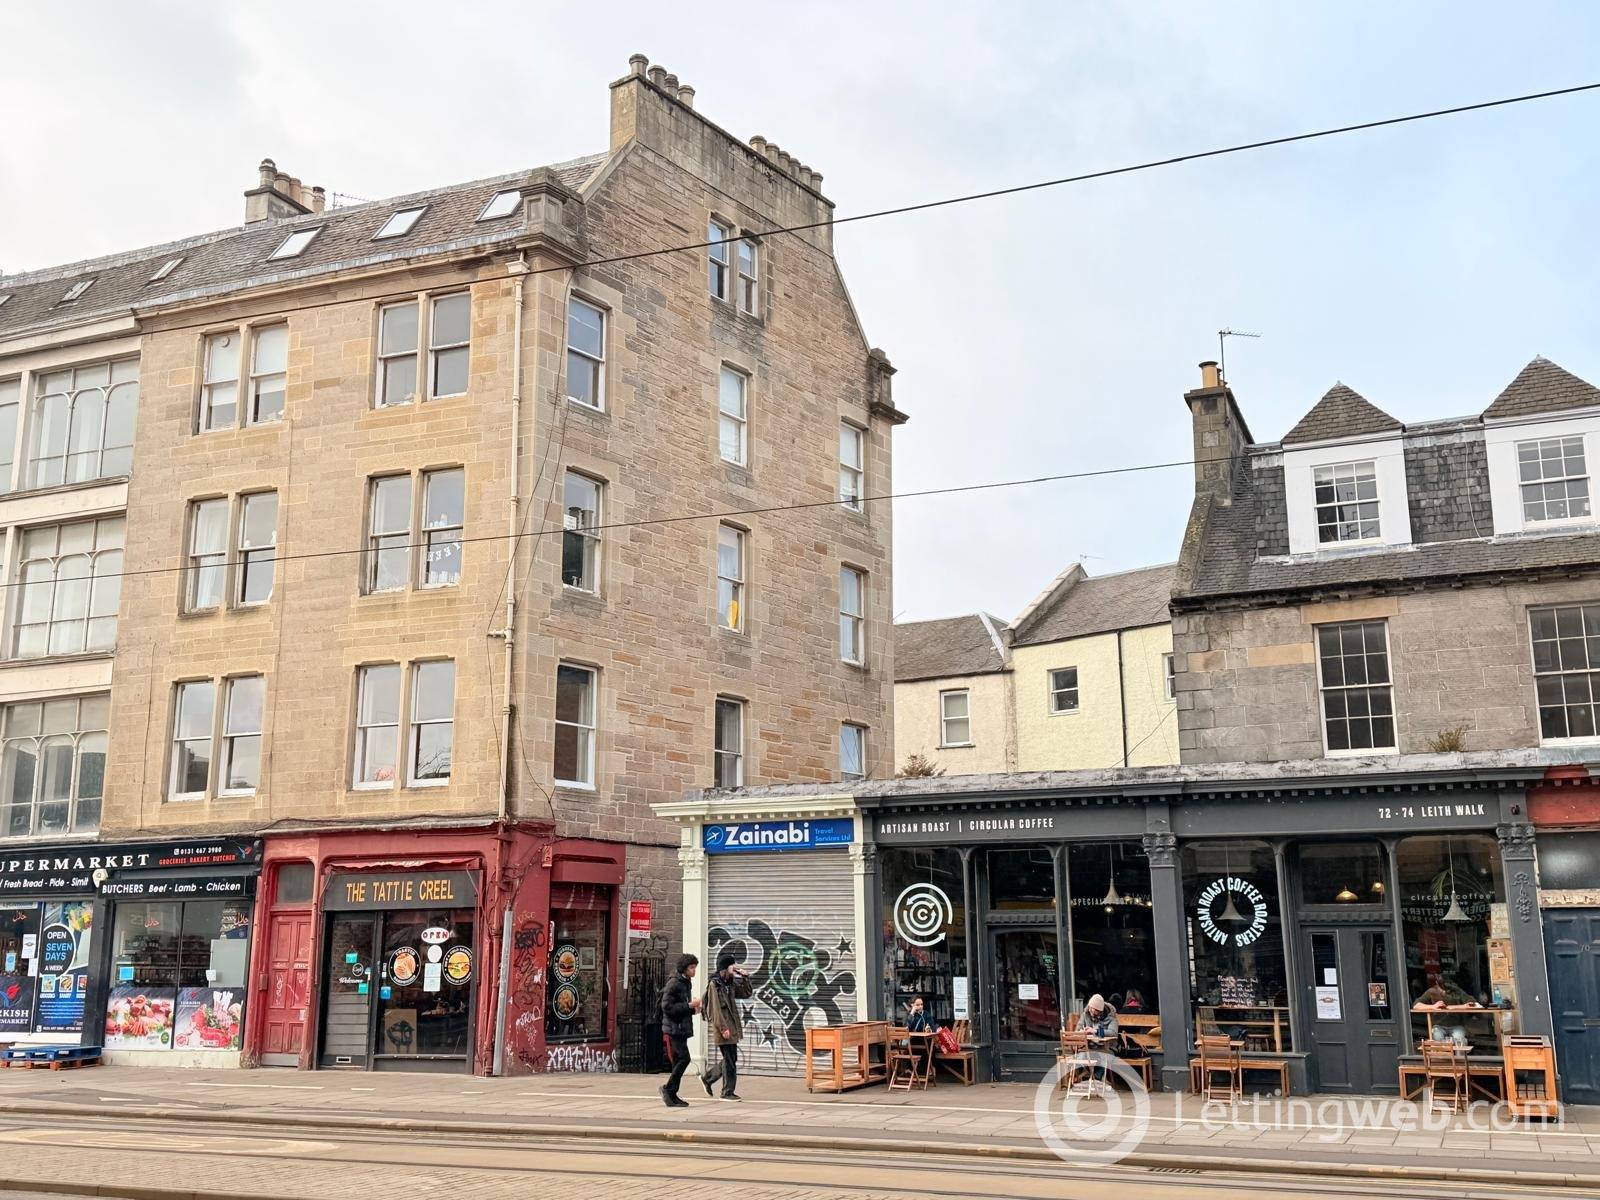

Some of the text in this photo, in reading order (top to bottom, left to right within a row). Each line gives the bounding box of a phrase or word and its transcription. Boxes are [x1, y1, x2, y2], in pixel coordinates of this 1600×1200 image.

[1378, 807, 1391, 819] 72
[1401, 806, 1414, 818] 74
[1421, 805, 1452, 817] LEITH
[1454, 804, 1485, 816] WALK
[814, 827, 834, 835] Travel
[880, 823, 918, 834] ARTISAN
[921, 821, 950, 833] ROAST
[969, 818, 1015, 831] CIRCULAR
[1018, 817, 1054, 829] COFFEE
[725, 821, 810, 846] Zainabi
[4, 879, 21, 888] Fresh
[23, 878, 43, 888] Bread
[49, 877, 65, 887] Pide
[71, 876, 89, 887] Simit
[102, 884, 144, 894] BUTCHERS
[148, 884, 168, 893] Beef
[174, 882, 197, 892] Lamb
[206, 881, 241, 892] Chicken
[346, 879, 454, 903] THE TATTIE CREEL
[1410, 893, 1455, 901] circula
[1197, 876, 1268, 947] ARTISAN ROAST COFFEE ROASTERS
[46, 931, 67, 940] OPEN
[422, 931, 448, 939] OPEN
[46, 943, 73, 952] SEVEN
[45, 952, 67, 960] DAYS
